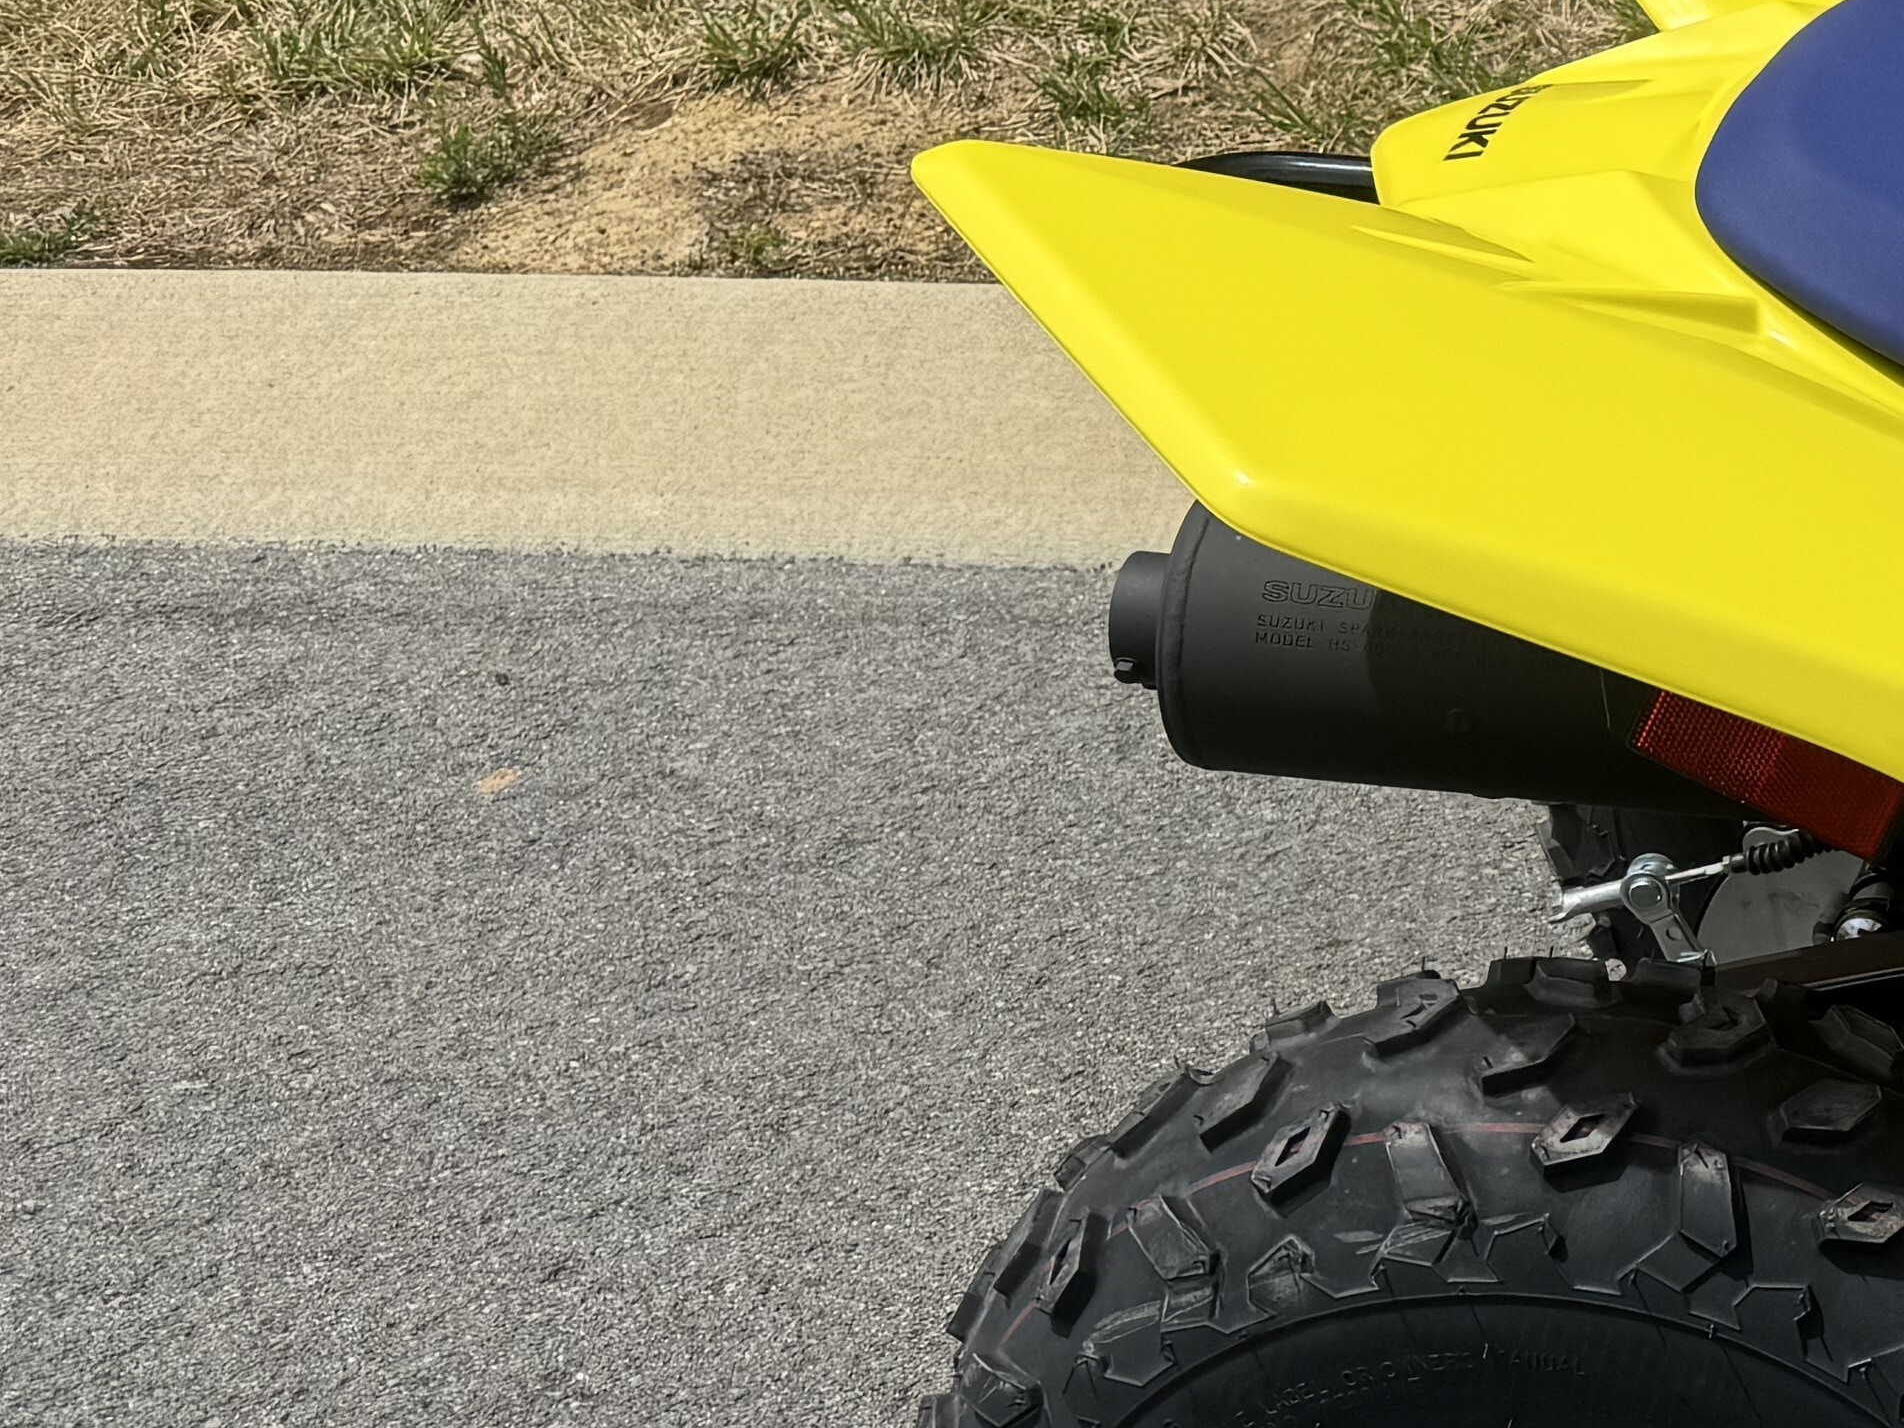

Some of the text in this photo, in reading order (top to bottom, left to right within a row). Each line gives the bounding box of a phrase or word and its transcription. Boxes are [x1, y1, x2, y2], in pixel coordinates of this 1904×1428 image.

[1443, 84, 1554, 161] SUZUKI
[1256, 614, 1324, 633] SUZUKI
[1255, 631, 1314, 649] MODEL
